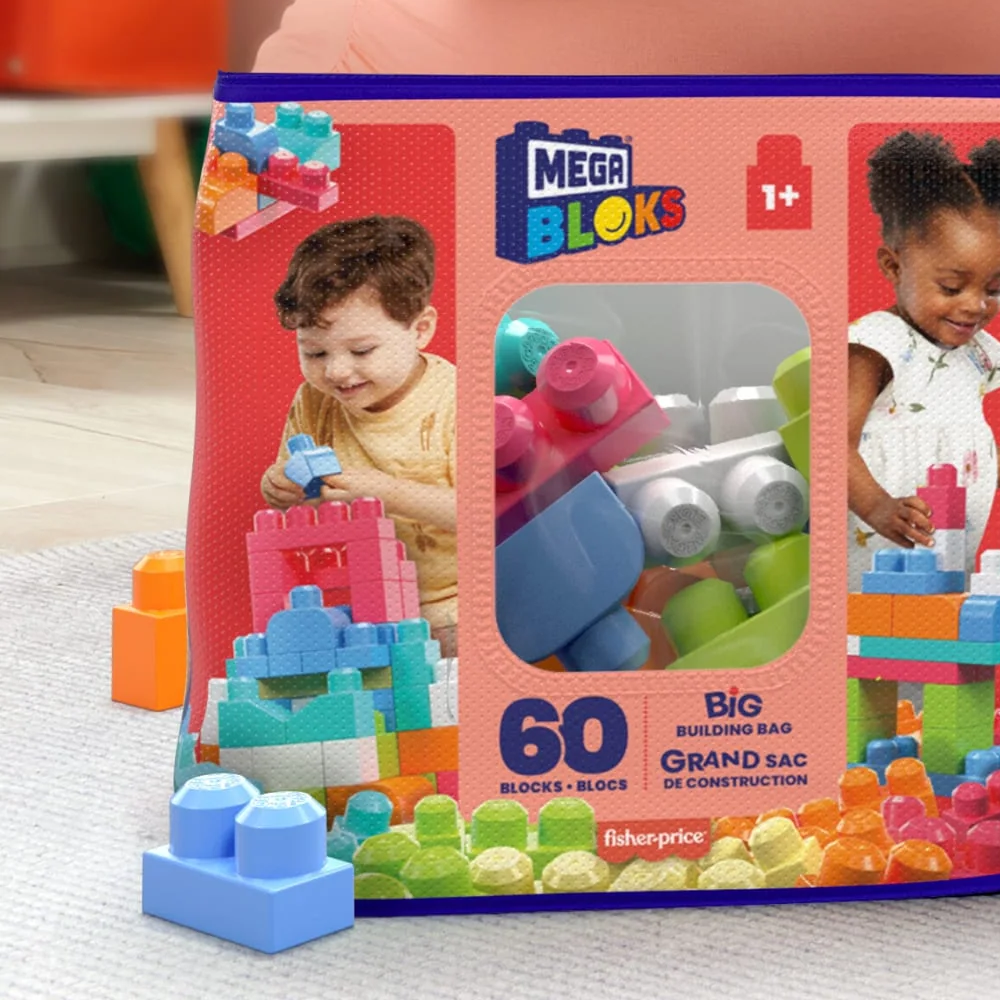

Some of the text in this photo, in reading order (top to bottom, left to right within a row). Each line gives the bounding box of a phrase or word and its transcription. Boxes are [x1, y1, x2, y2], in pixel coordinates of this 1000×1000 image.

[534, 147, 624, 191] MEGA
[761, 184, 800, 211] 1+
[527, 188, 684, 259] BLOKS
[499, 695, 629, 777] 60
[676, 722, 793, 738] BUILDING BAG
[660, 749, 809, 774] GRAND SAC
[500, 778, 628, 795] BLOCKS BLOCS
[663, 774, 809, 790] DE CONSTRUCTION
[604, 827, 705, 850] fisher-price
